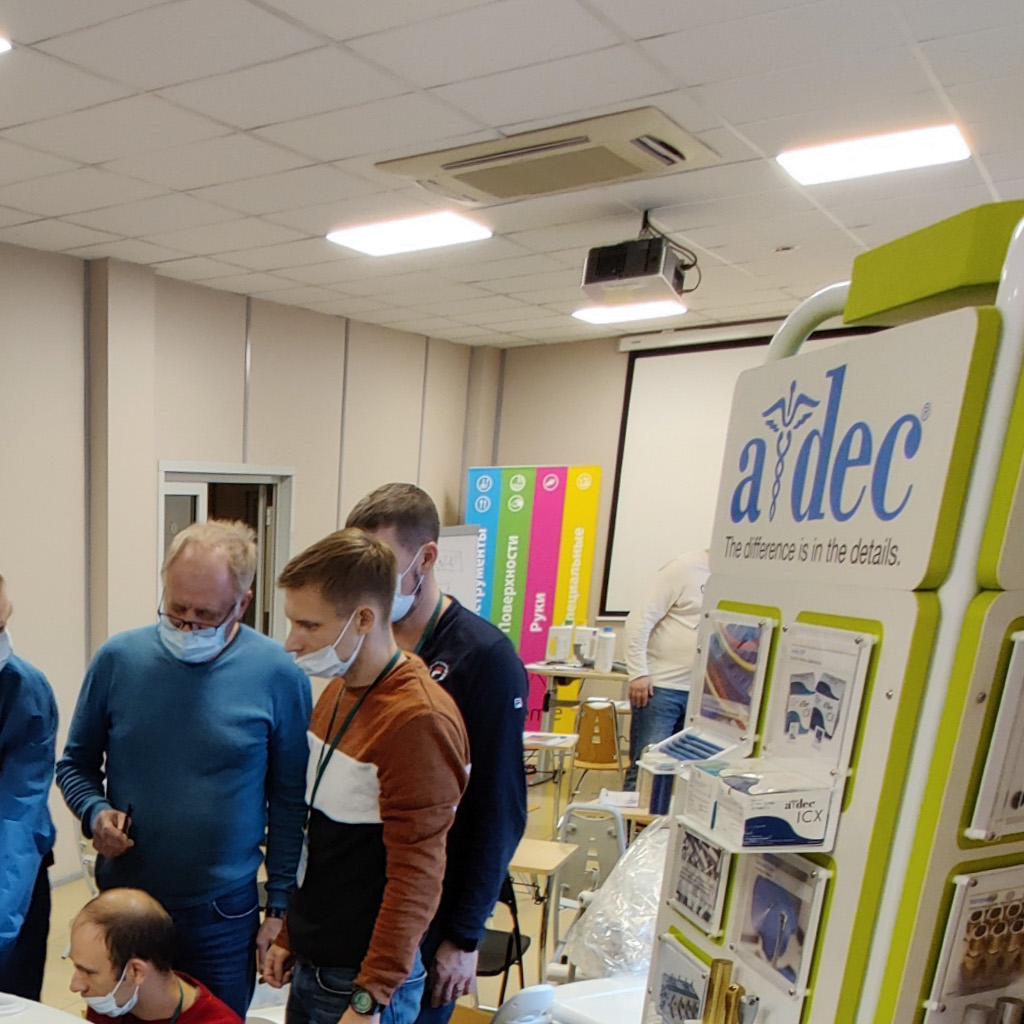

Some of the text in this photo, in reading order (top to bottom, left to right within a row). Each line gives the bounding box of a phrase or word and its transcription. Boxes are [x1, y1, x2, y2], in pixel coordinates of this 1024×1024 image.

[724, 535, 742, 559] The
[744, 536, 796, 561] difference
[798, 537, 809, 561] is
[810, 538, 824, 562] in
[826, 538, 848, 563] the
[498, 535, 519, 632] Поверхности
[565, 526, 585, 621] пециальные
[529, 592, 546, 633] Руки
[796, 809, 824, 823] ICX
